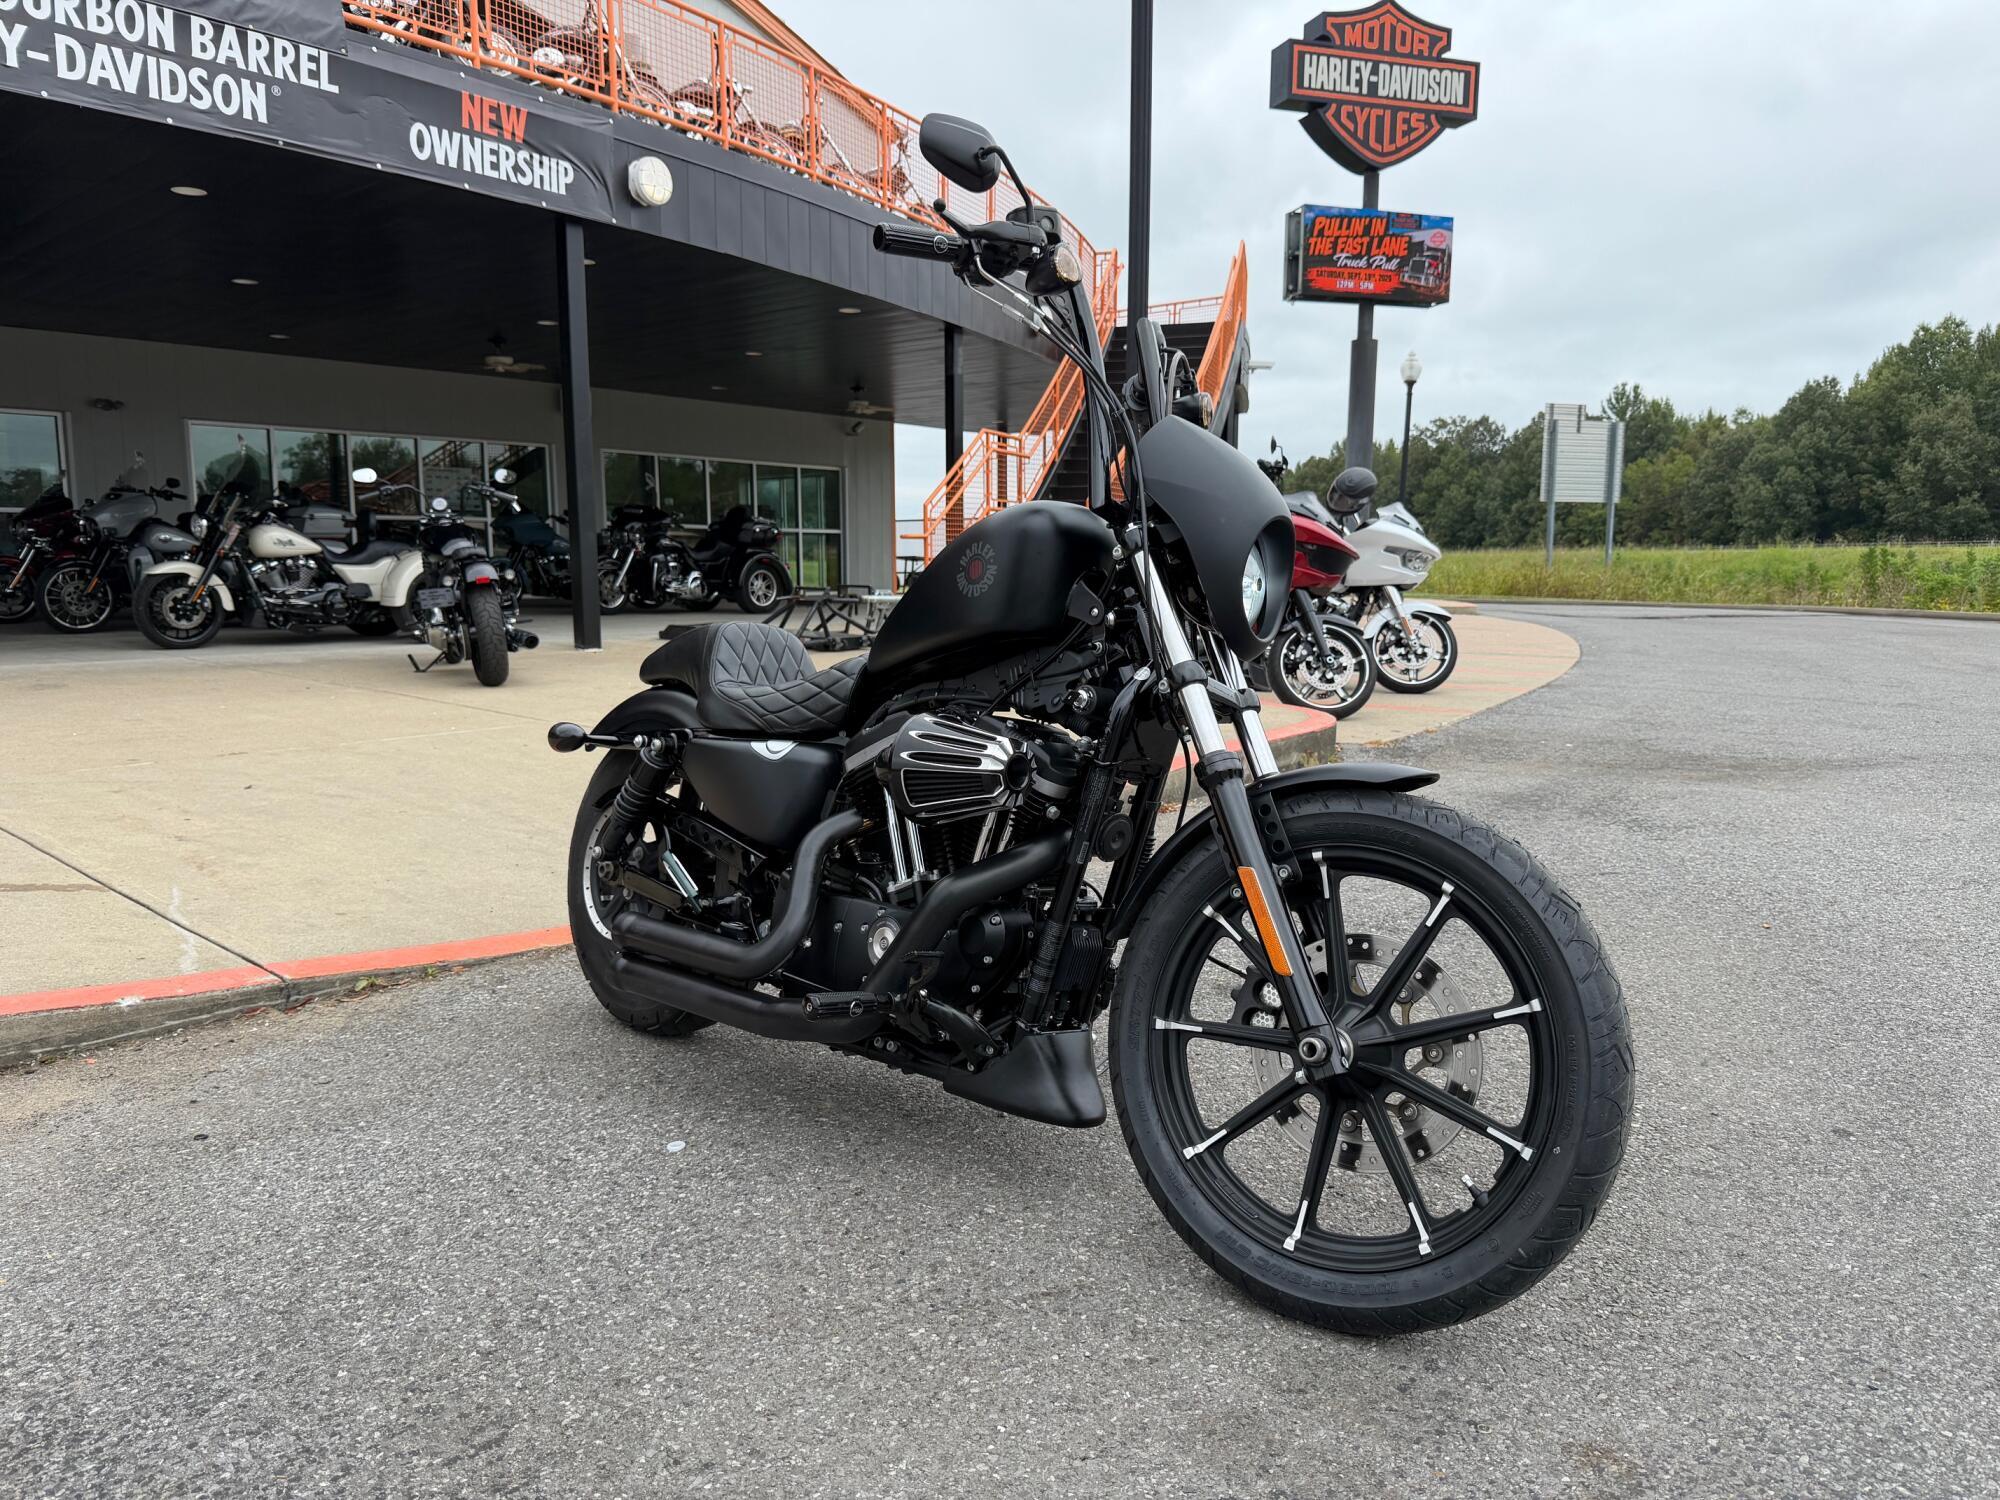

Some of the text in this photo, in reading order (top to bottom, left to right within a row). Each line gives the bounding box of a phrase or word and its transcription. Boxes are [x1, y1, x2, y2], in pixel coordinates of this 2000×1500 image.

[0, 0, 340, 94] RBON BARREL
[1344, 13, 1430, 57] MOTOR
[1303, 54, 1465, 105] HARLEY-DAVIDSON
[461, 90, 528, 144] NEW
[1341, 103, 1427, 153] CYCLES
[409, 122, 574, 195] OWNERSHIP
[1308, 236, 1335, 256] THE
[1336, 236, 1370, 256] FAST
[1370, 236, 1409, 257] LANE
[1313, 216, 1369, 237] PULLIN'
[1370, 217, 1387, 237] IN
[1333, 253, 1401, 270] Truck Pull
[960, 542, 995, 567] HARLEY
[956, 565, 997, 598] DAVIDSON
